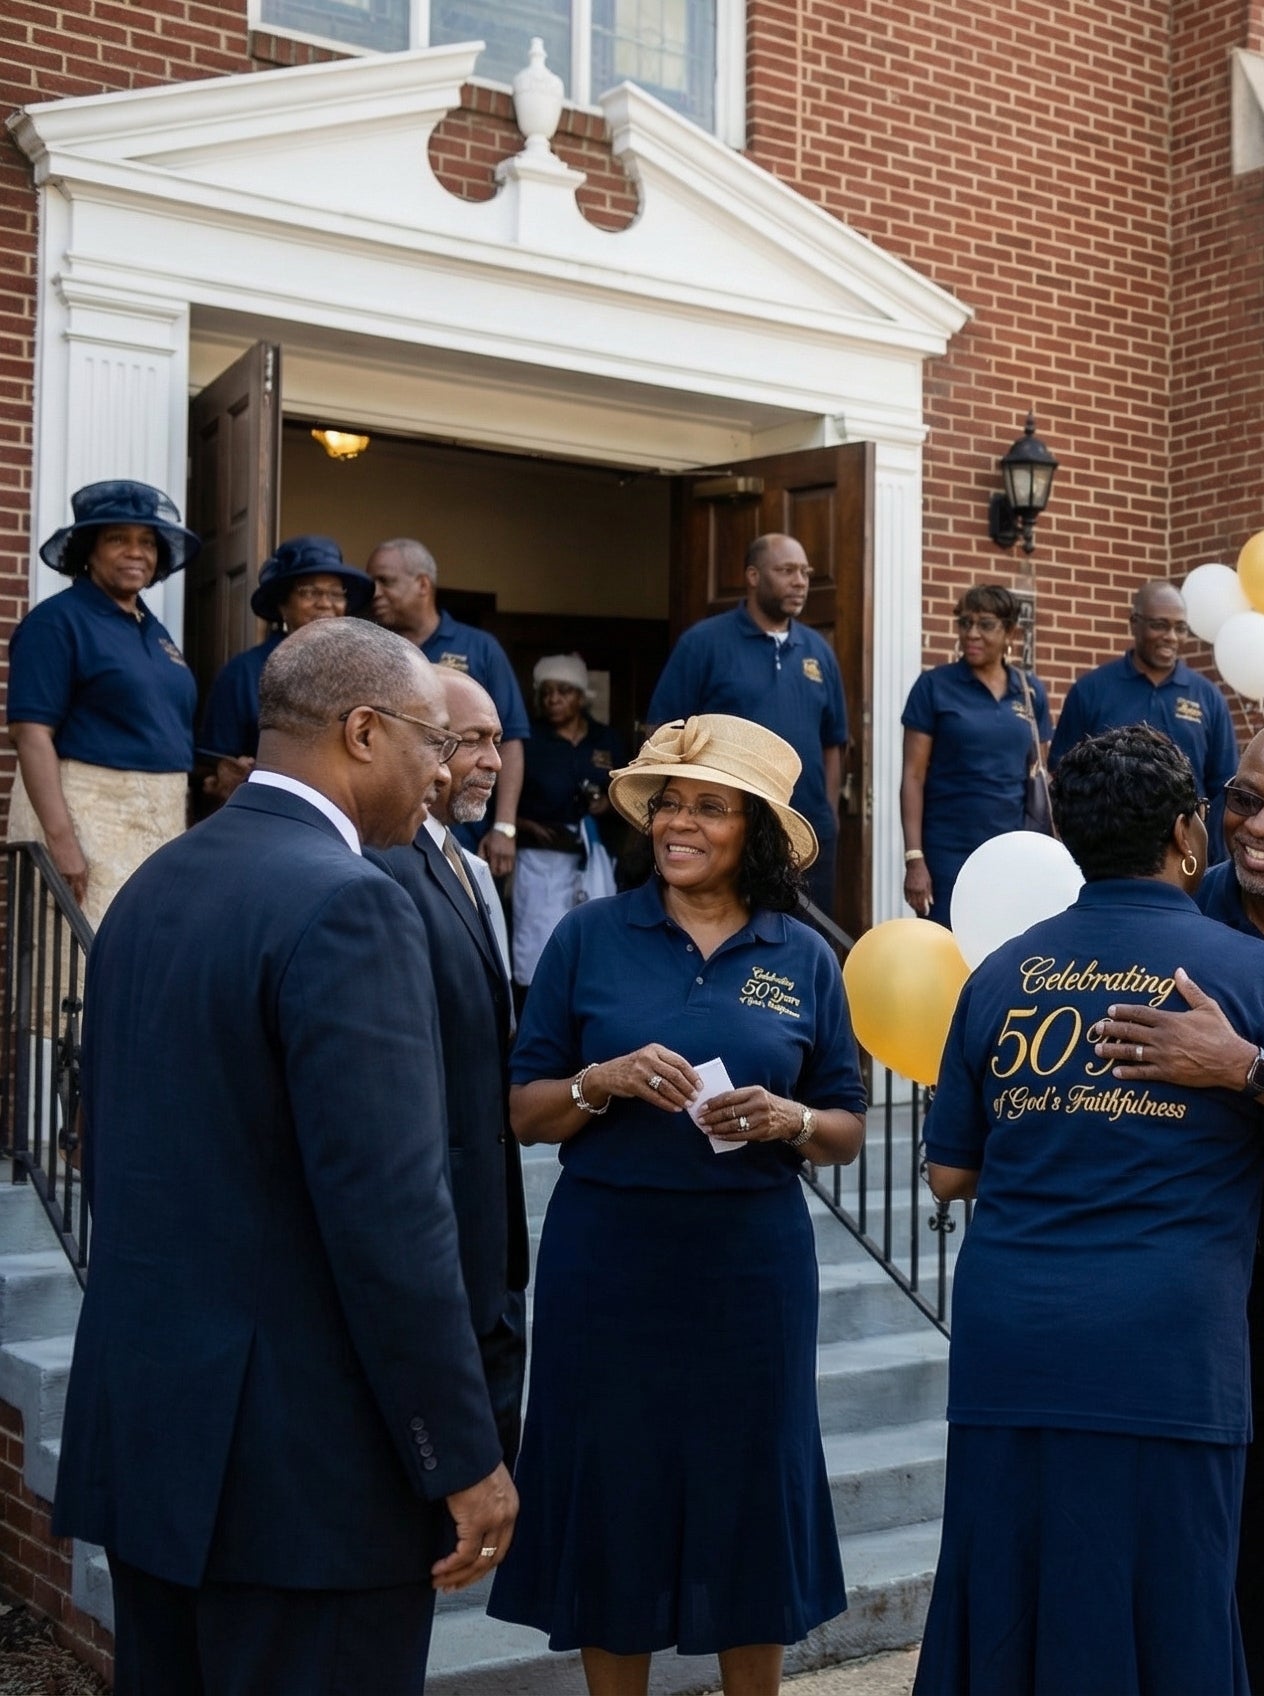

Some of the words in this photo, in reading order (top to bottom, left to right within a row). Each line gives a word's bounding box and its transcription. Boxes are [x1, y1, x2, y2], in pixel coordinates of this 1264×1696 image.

[741, 978, 770, 999] 50
[1020, 956, 1177, 1007] Celebrating
[991, 1005, 1082, 1078] 50
[993, 1089, 1008, 1119] of
[1007, 1086, 1062, 1121] God's
[1065, 1084, 1187, 1122] Faithfulness
